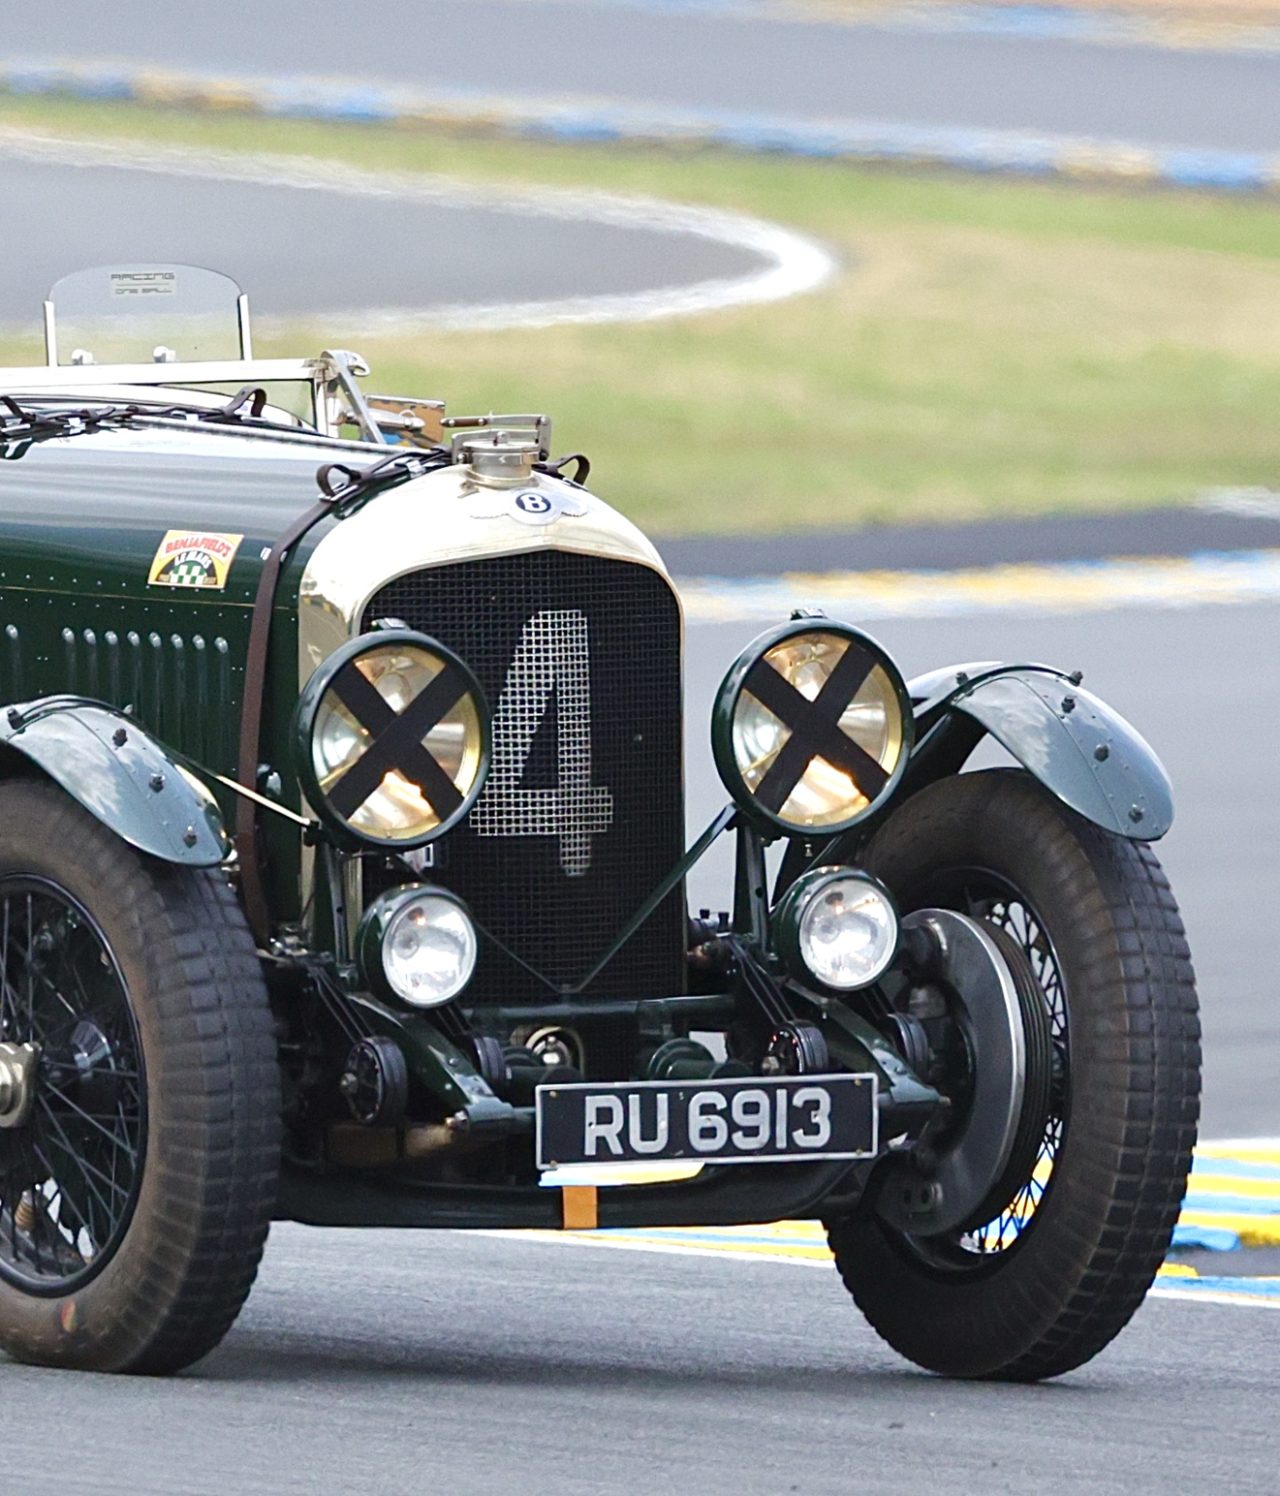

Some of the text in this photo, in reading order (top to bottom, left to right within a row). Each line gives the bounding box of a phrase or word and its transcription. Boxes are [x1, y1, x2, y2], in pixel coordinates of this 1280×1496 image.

[518, 493, 550, 513] B
[470, 609, 614, 877] 4
[584, 1086, 832, 1156] RU 6913
